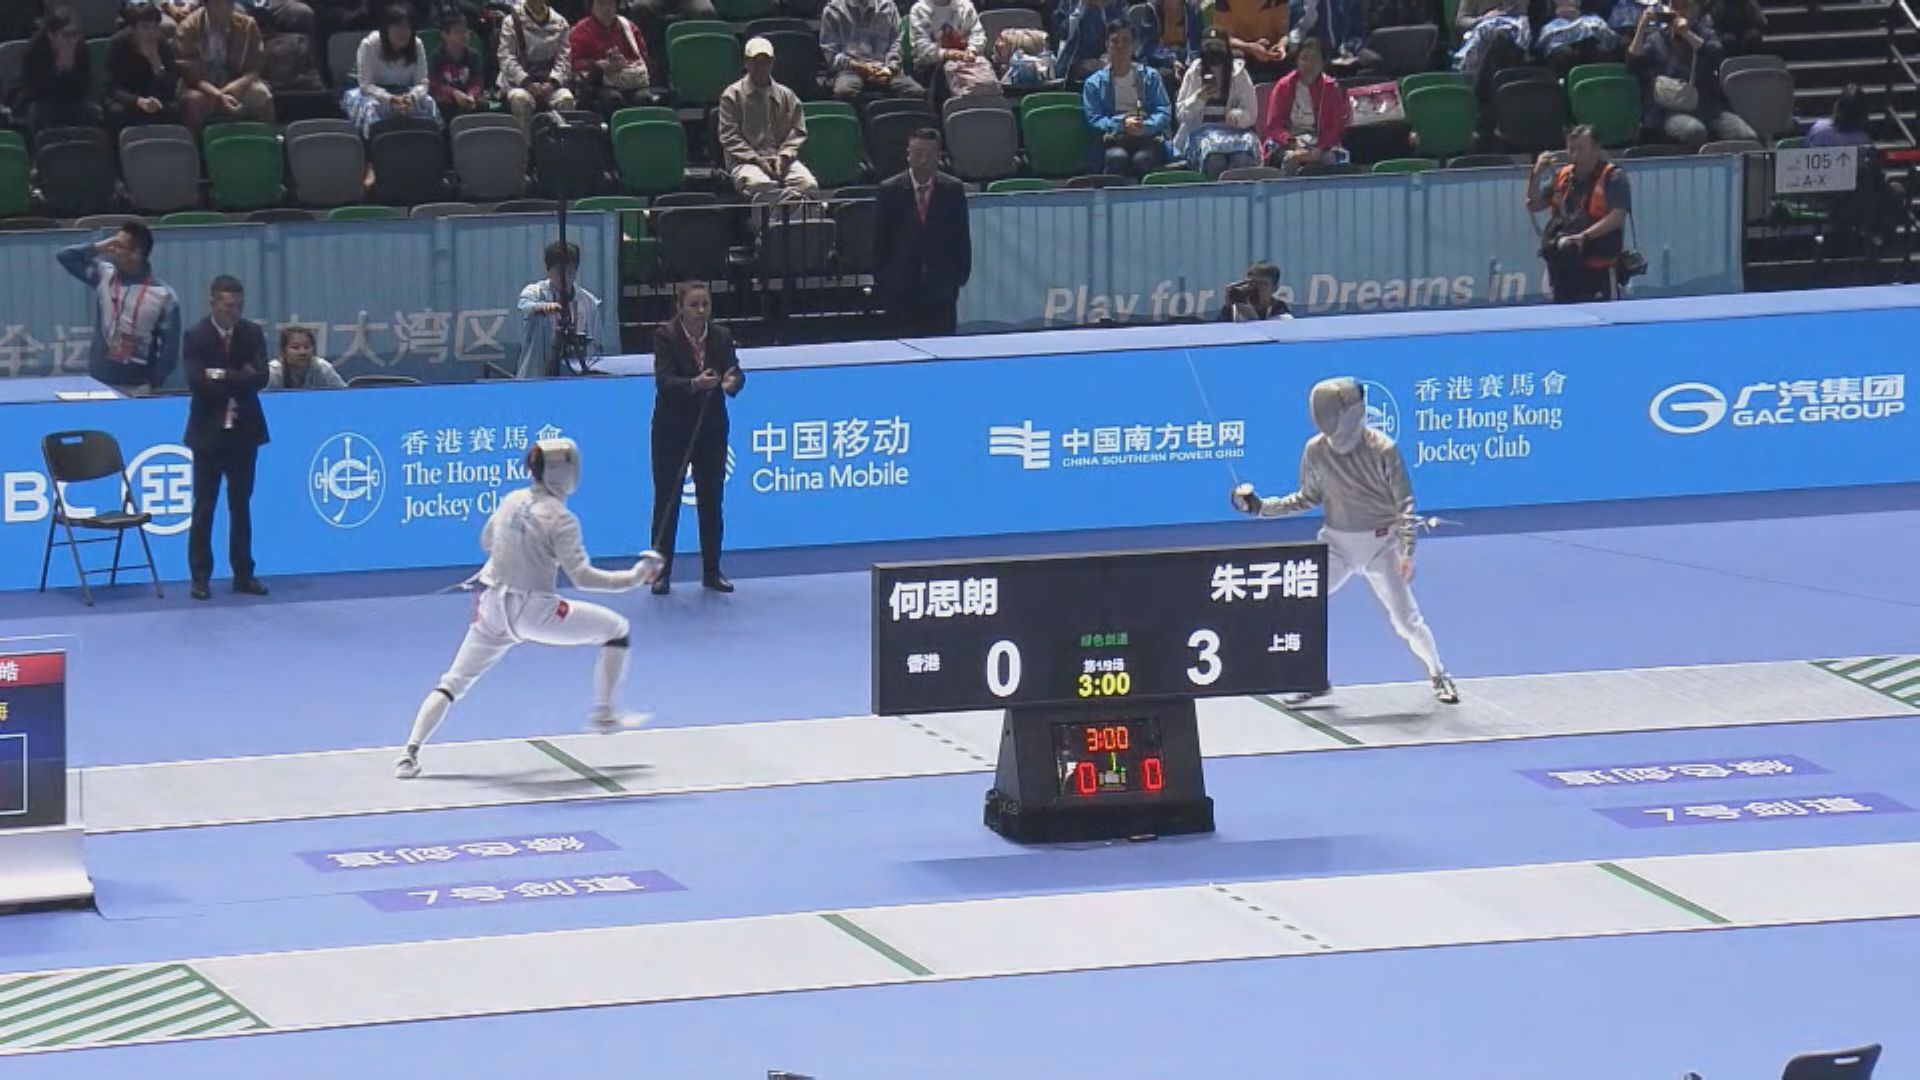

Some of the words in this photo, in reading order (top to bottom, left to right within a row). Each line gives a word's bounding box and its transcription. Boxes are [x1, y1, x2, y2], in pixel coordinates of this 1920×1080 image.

[1806, 154, 1831, 169] 105
[1045, 284, 1139, 326] Play
[1151, 280, 1214, 321] for
[1307, 273, 1475, 313] Dreams
[1490, 261, 1526, 303] in
[1415, 370, 1567, 402] 香港賽馬會
[1733, 374, 1905, 410] 广汽集团
[1416, 408, 1452, 431] The
[1457, 407, 1508, 433] Hong
[1512, 404, 1563, 430] Kong
[1732, 407, 1795, 426] GAC
[1799, 401, 1905, 422] GROUP
[752, 415, 910, 463] 中国移动
[1061, 419, 1245, 456] 中国南方电网
[1413, 437, 1481, 468] Jockey
[1484, 433, 1531, 459] Club
[403, 462, 442, 486] The
[447, 461, 502, 487] Hong
[506, 457, 531, 481] Ko
[1062, 457, 1100, 468] CHINA
[1102, 453, 1167, 466] SOUTHERN
[1169, 449, 1214, 462] POWER
[1215, 447, 1245, 459] GRID
[752, 465, 824, 493] China
[829, 460, 910, 489] Mobile
[401, 491, 473, 523] Jockey
[477, 489, 503, 515] Cl
[1210, 558, 1320, 603] 朱子皓
[888, 576, 1000, 622] 何思朗
[1186, 628, 1223, 686] 3
[1267, 632, 1302, 653] 上海
[906, 652, 941, 674] 香港
[986, 639, 1023, 698] 0
[1078, 672, 1131, 697] 3:00
[1086, 726, 1128, 751] 3:00
[1077, 761, 1097, 795] 0
[1144, 757, 1163, 791] 0
